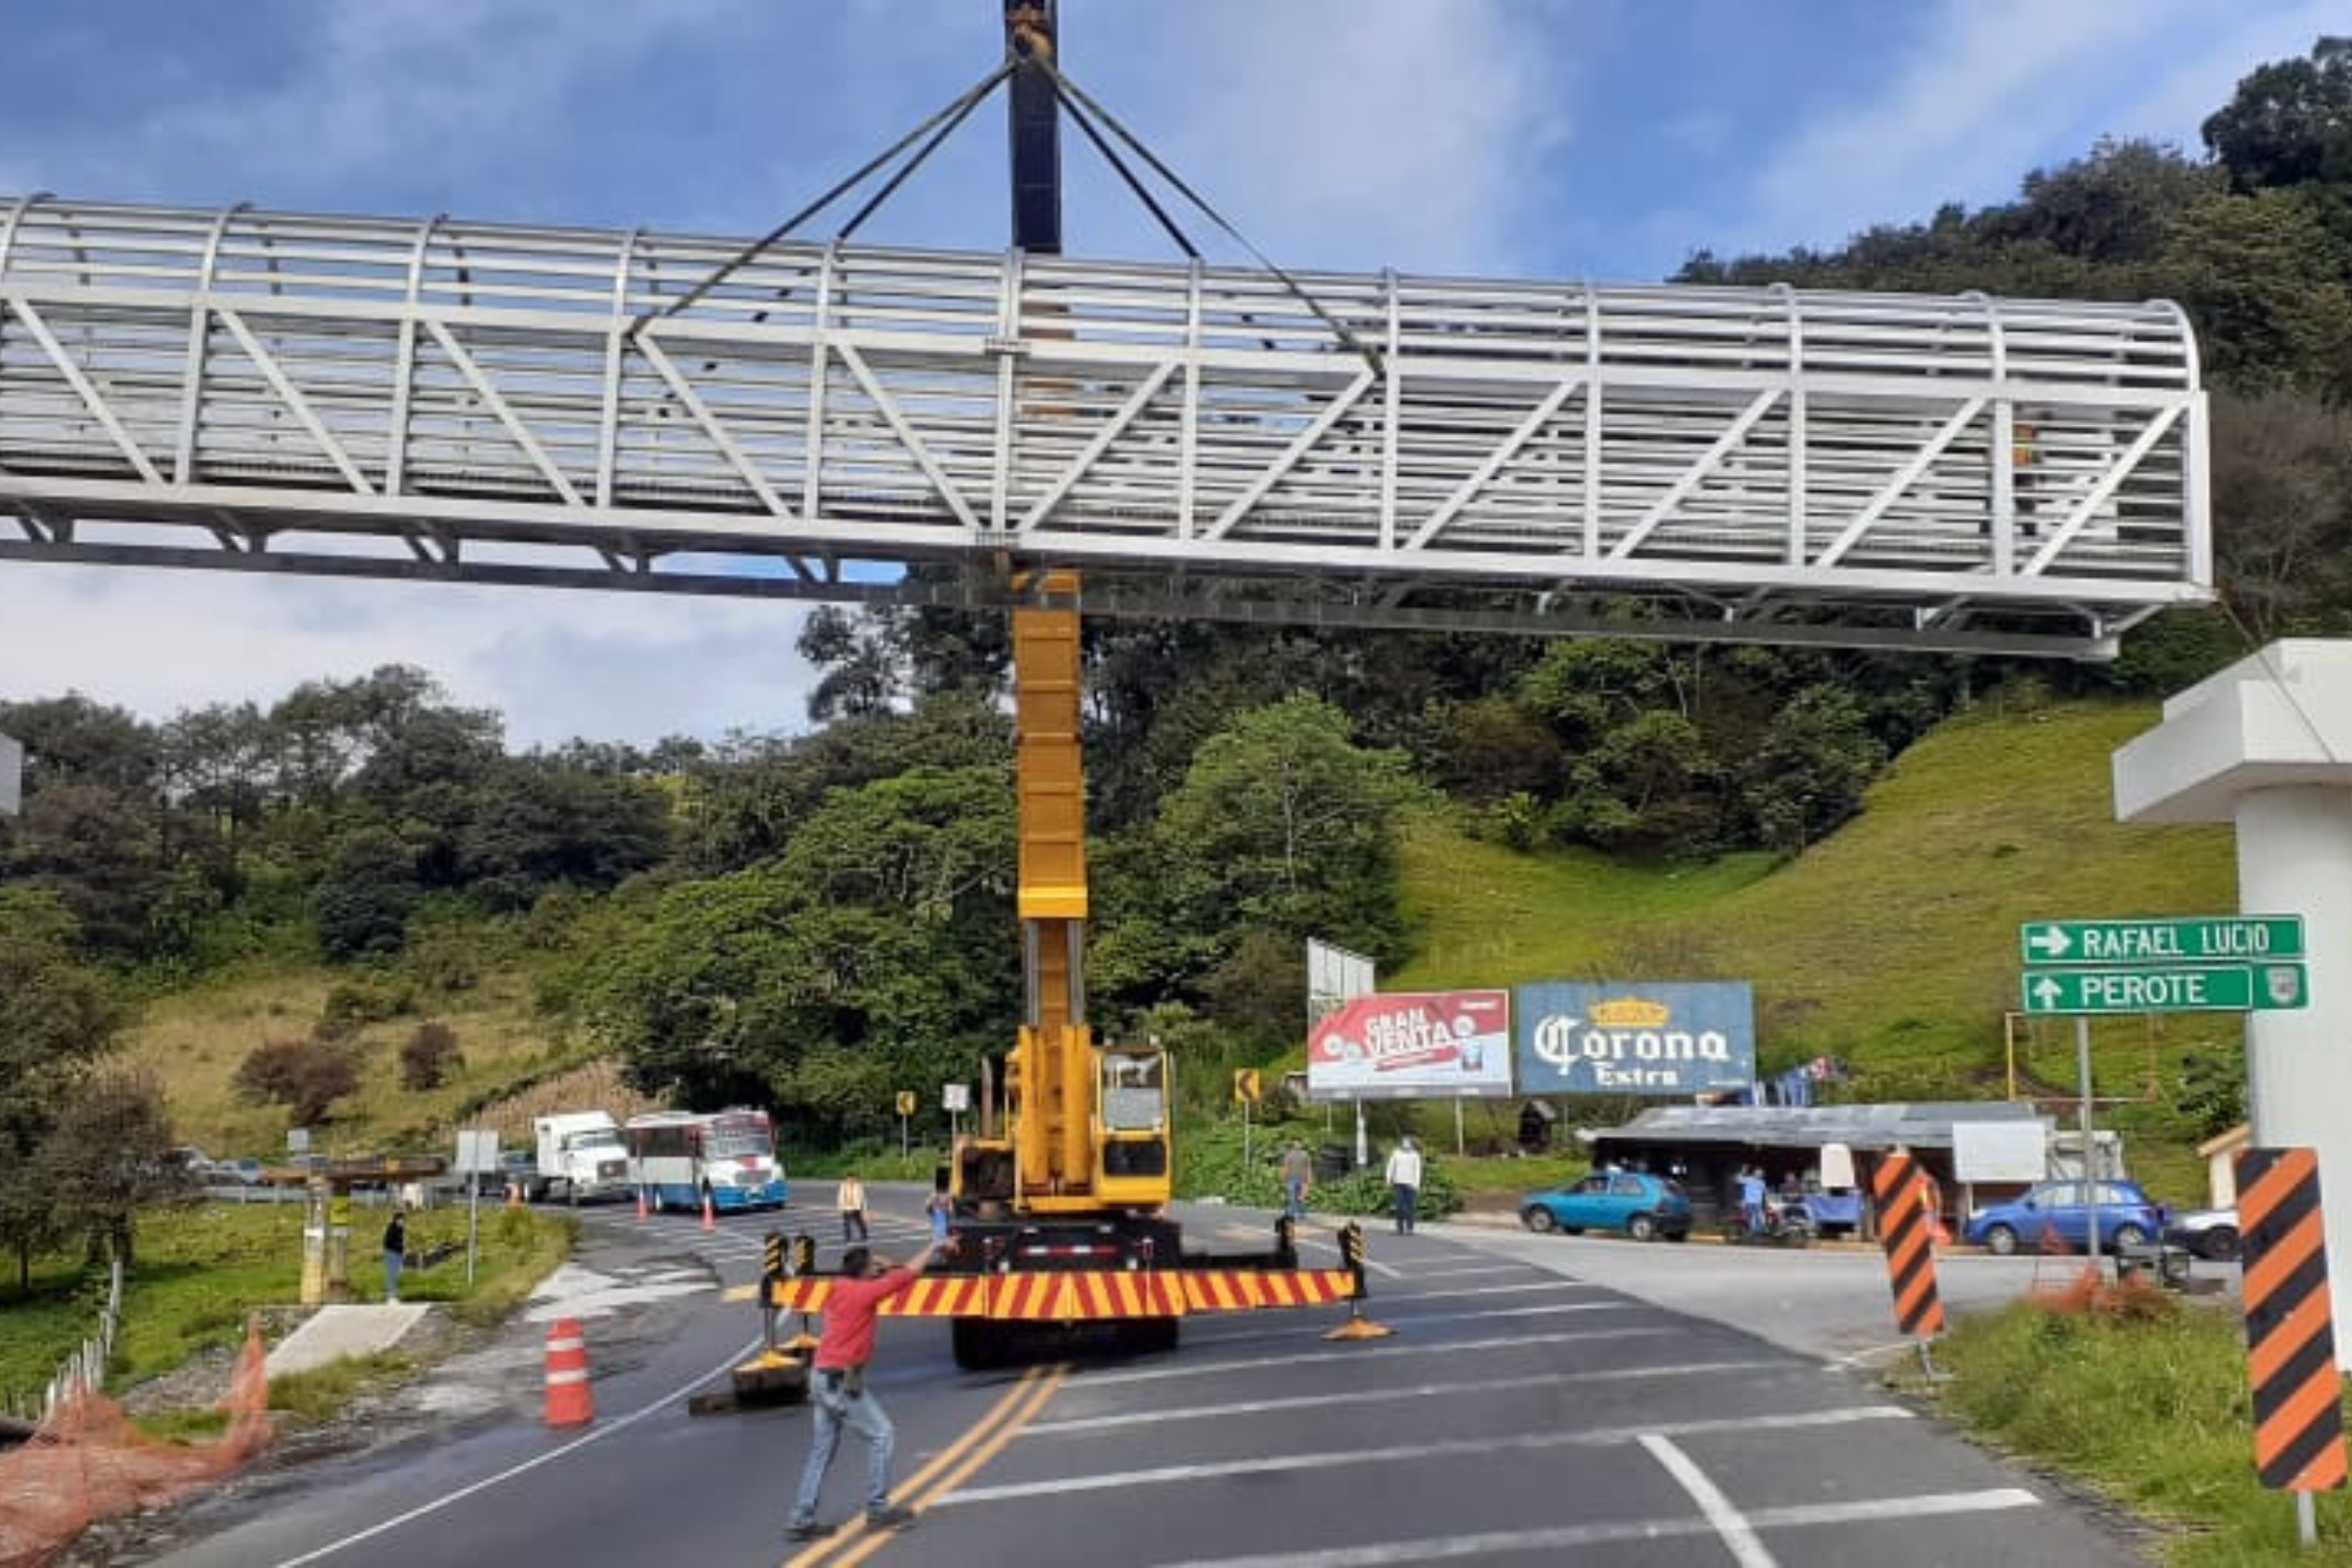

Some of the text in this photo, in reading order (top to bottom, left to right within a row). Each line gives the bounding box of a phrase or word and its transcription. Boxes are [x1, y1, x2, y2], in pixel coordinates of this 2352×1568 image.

[2083, 922, 2270, 957] RAFAEL LUCIO
[2079, 974, 2208, 1006] PEROTE
[1366, 1006, 1427, 1035] GRAN
[1364, 1021, 1455, 1057] VENTA
[1534, 1015, 1730, 1076] Corona
[1591, 1060, 1680, 1086] Extra
